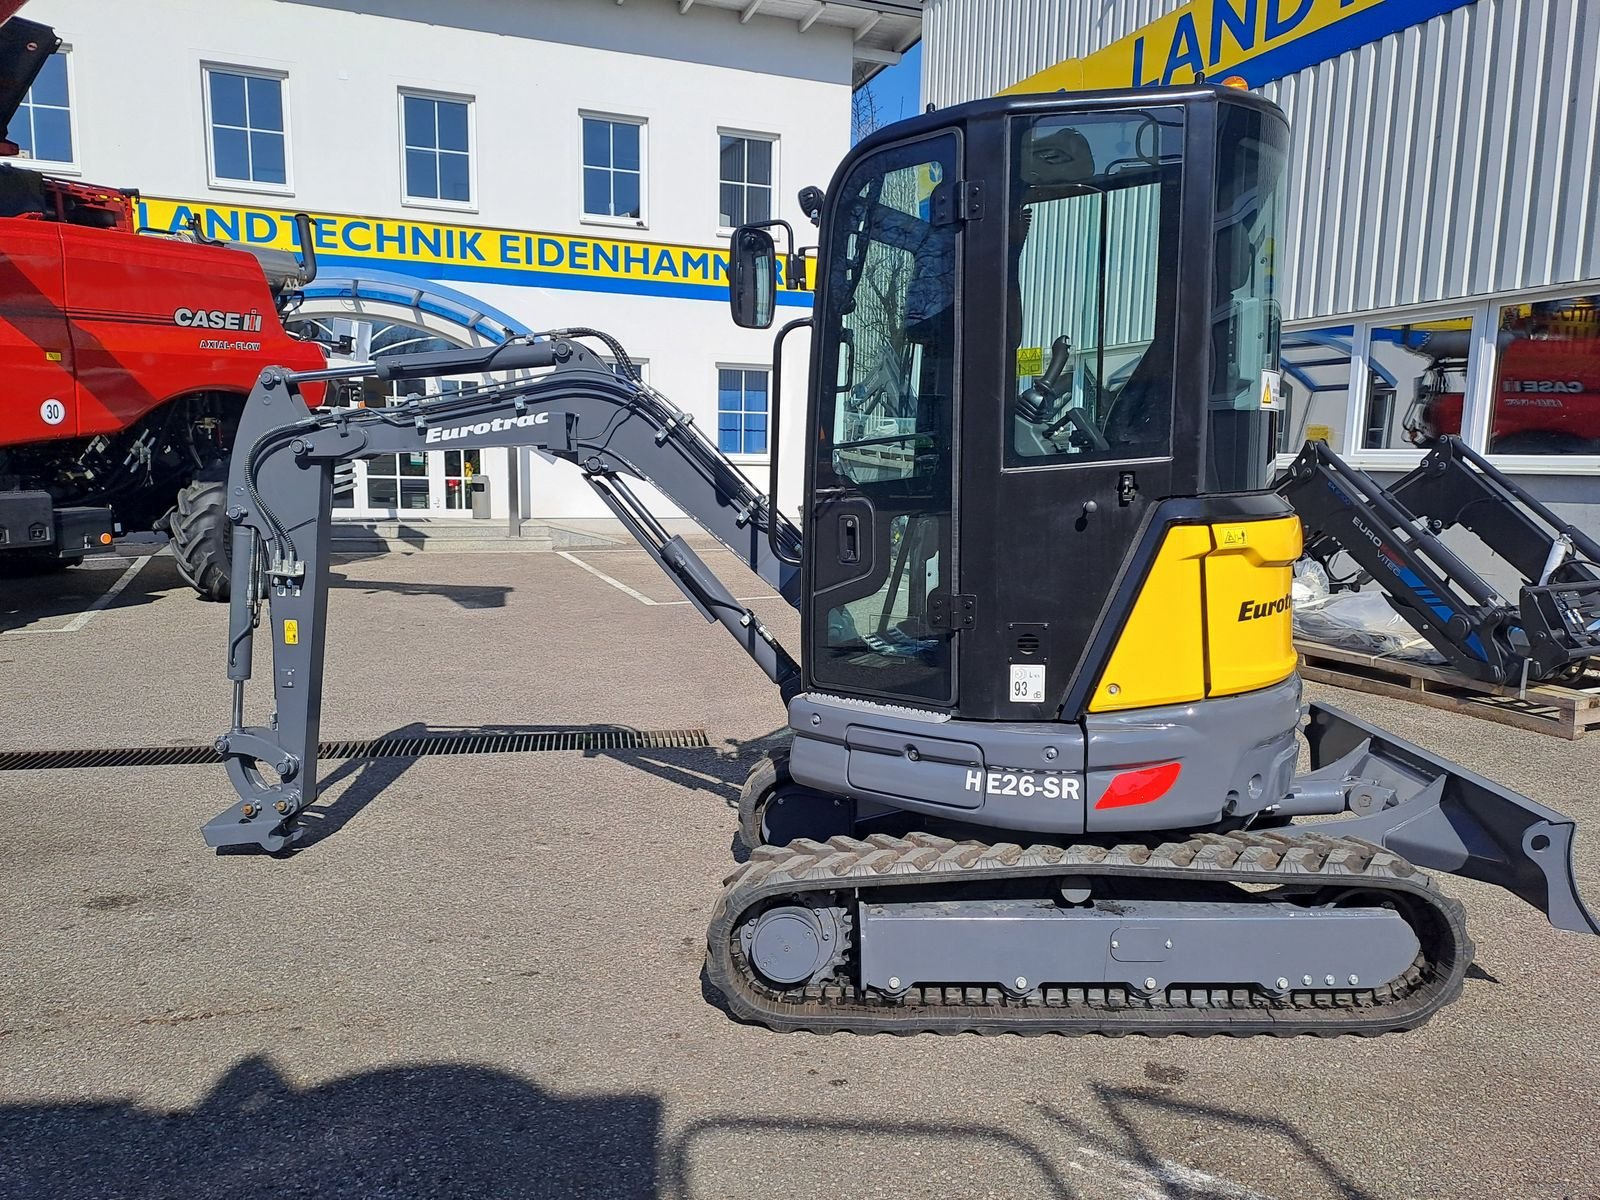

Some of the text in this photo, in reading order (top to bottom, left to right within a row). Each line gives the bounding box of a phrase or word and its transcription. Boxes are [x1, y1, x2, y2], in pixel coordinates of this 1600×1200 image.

[1132, 0, 1359, 87] LAND
[174, 307, 240, 330] CASE
[199, 339, 261, 351] AXIAL-FLOW
[46, 404, 60, 420] 30
[425, 411, 549, 444] Eurotrac
[1352, 516, 1383, 548] EURO
[1014, 681, 1028, 697] 93
